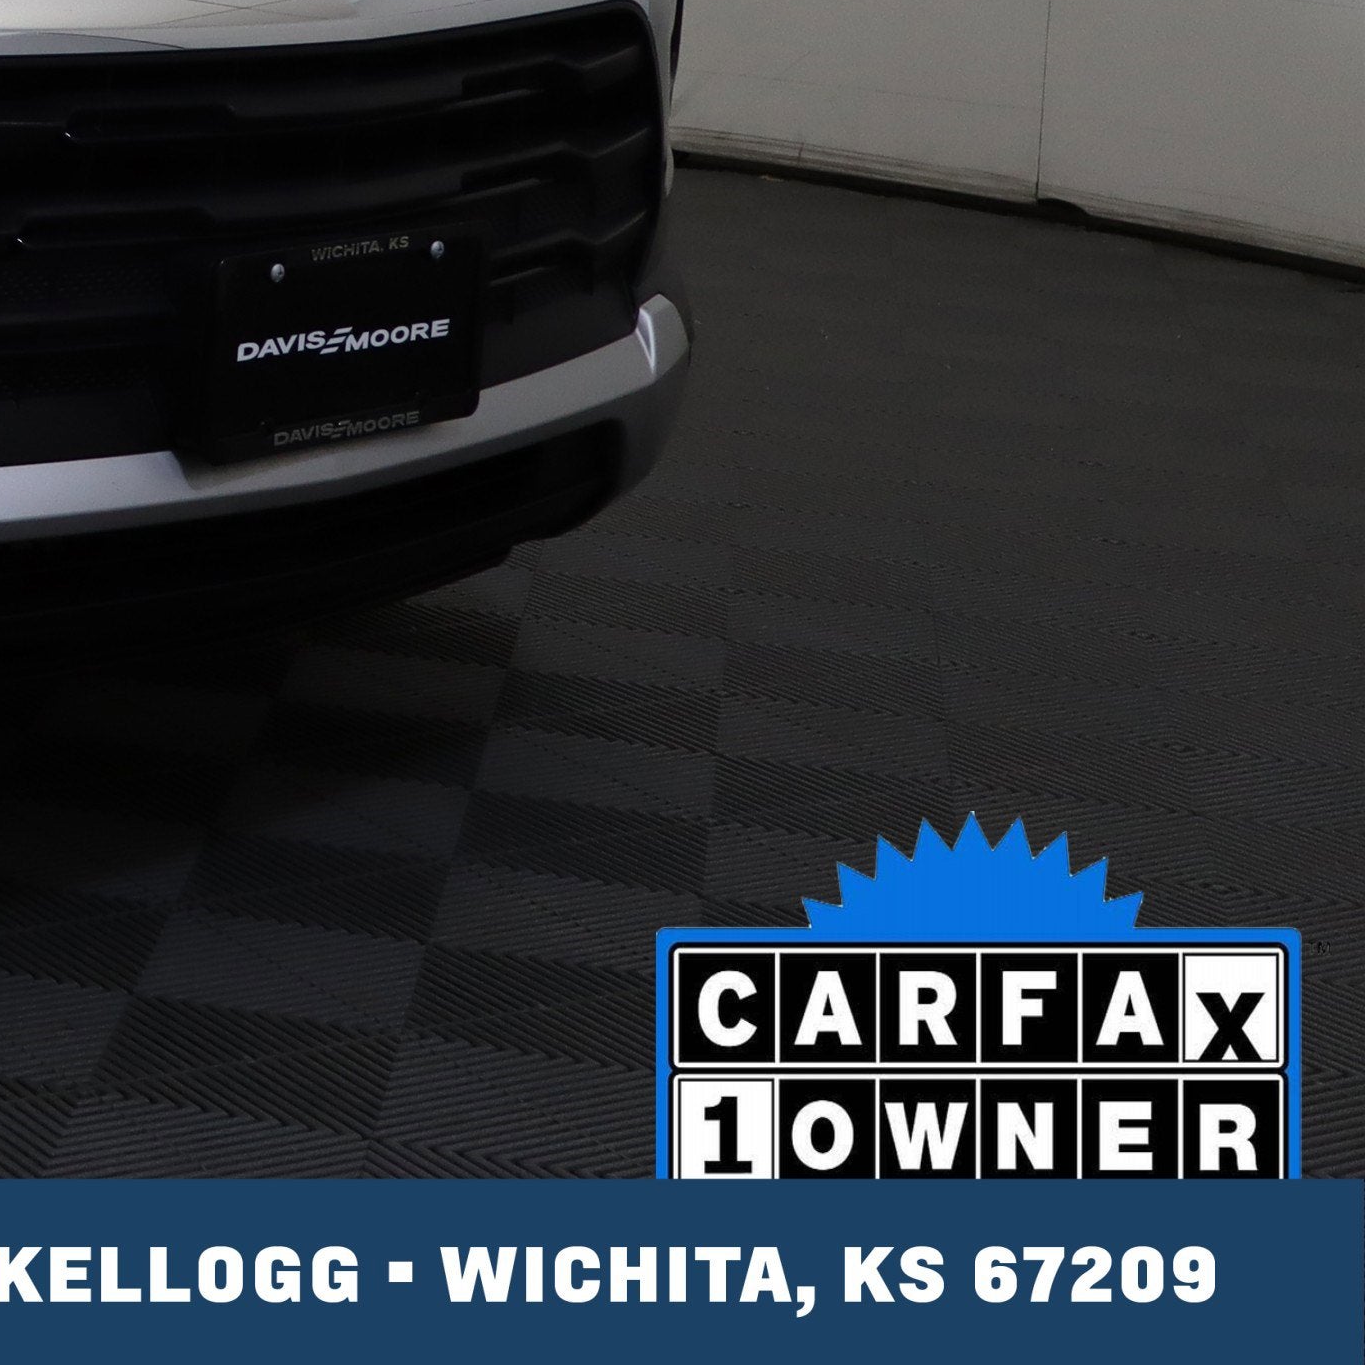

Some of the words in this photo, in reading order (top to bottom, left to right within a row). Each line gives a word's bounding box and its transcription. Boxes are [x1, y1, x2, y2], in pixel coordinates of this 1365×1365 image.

[389, 235, 409, 250] KS
[236, 330, 327, 363] DAVIS
[344, 318, 451, 353] MOORE
